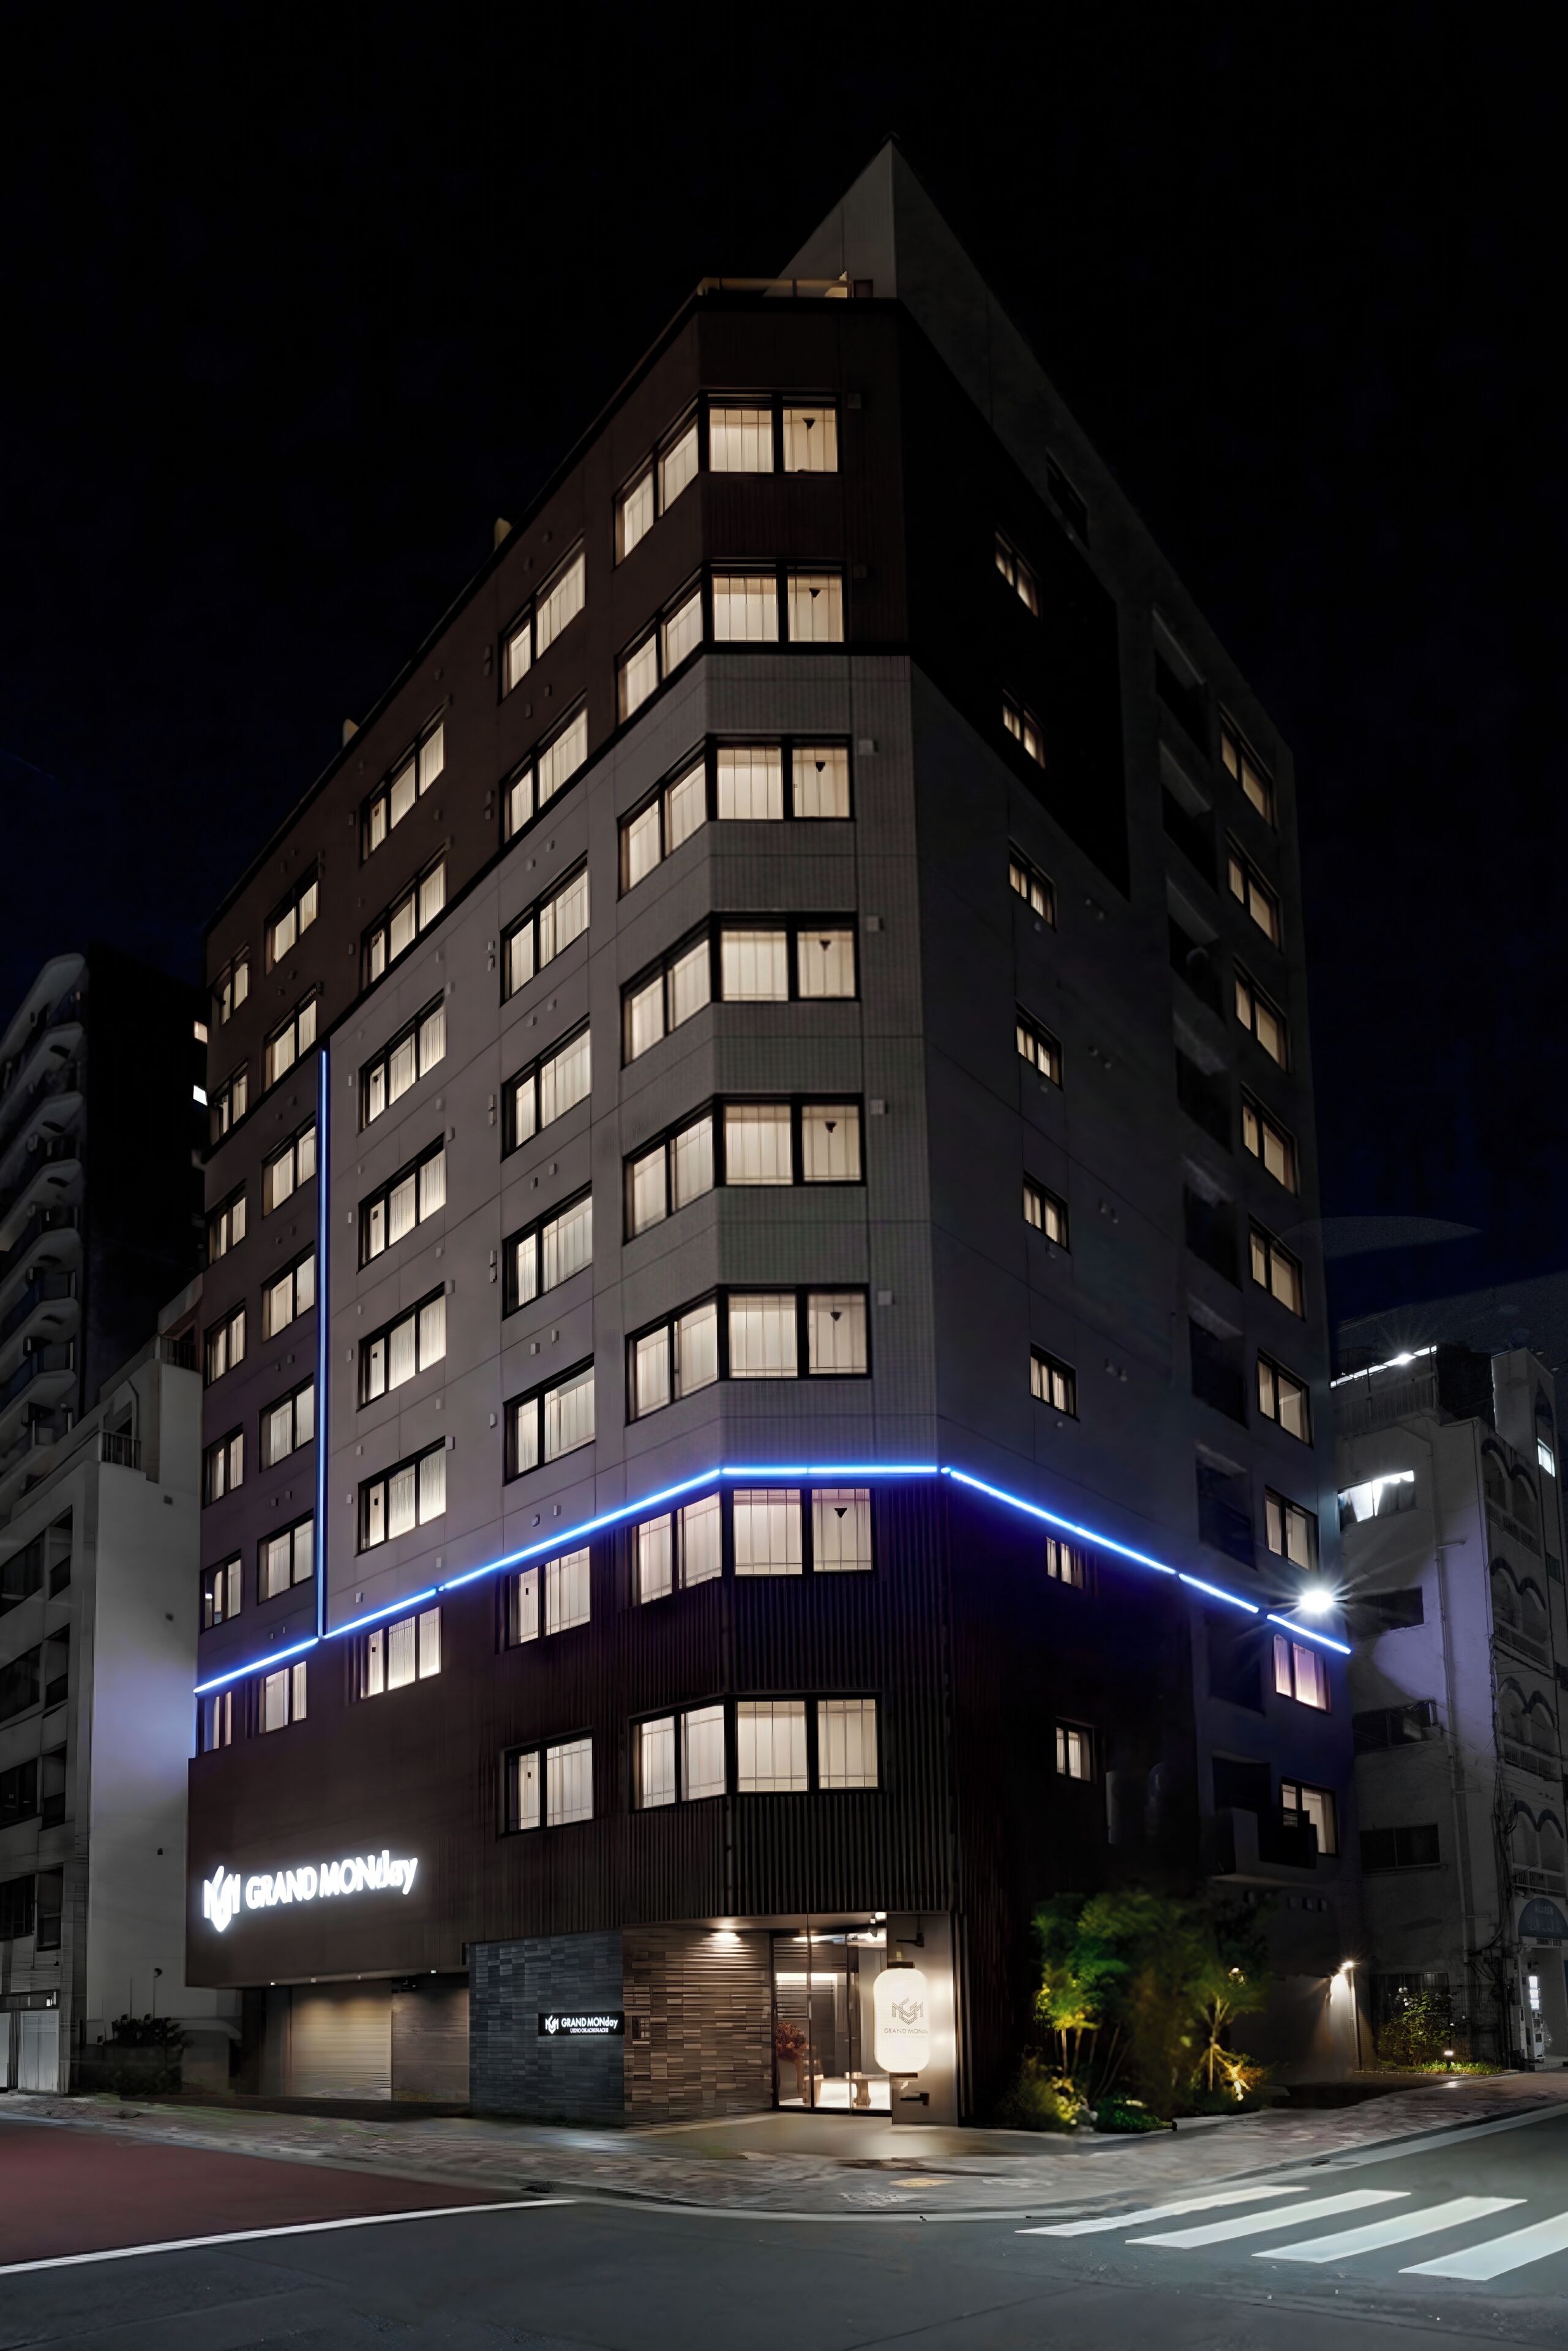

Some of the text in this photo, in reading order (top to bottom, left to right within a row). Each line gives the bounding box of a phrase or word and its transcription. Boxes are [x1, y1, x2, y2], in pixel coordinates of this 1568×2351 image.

[246, 1866, 318, 1909] GRAND
[561, 2017, 587, 2028] GRAND
[587, 2016, 618, 2029] MONday
